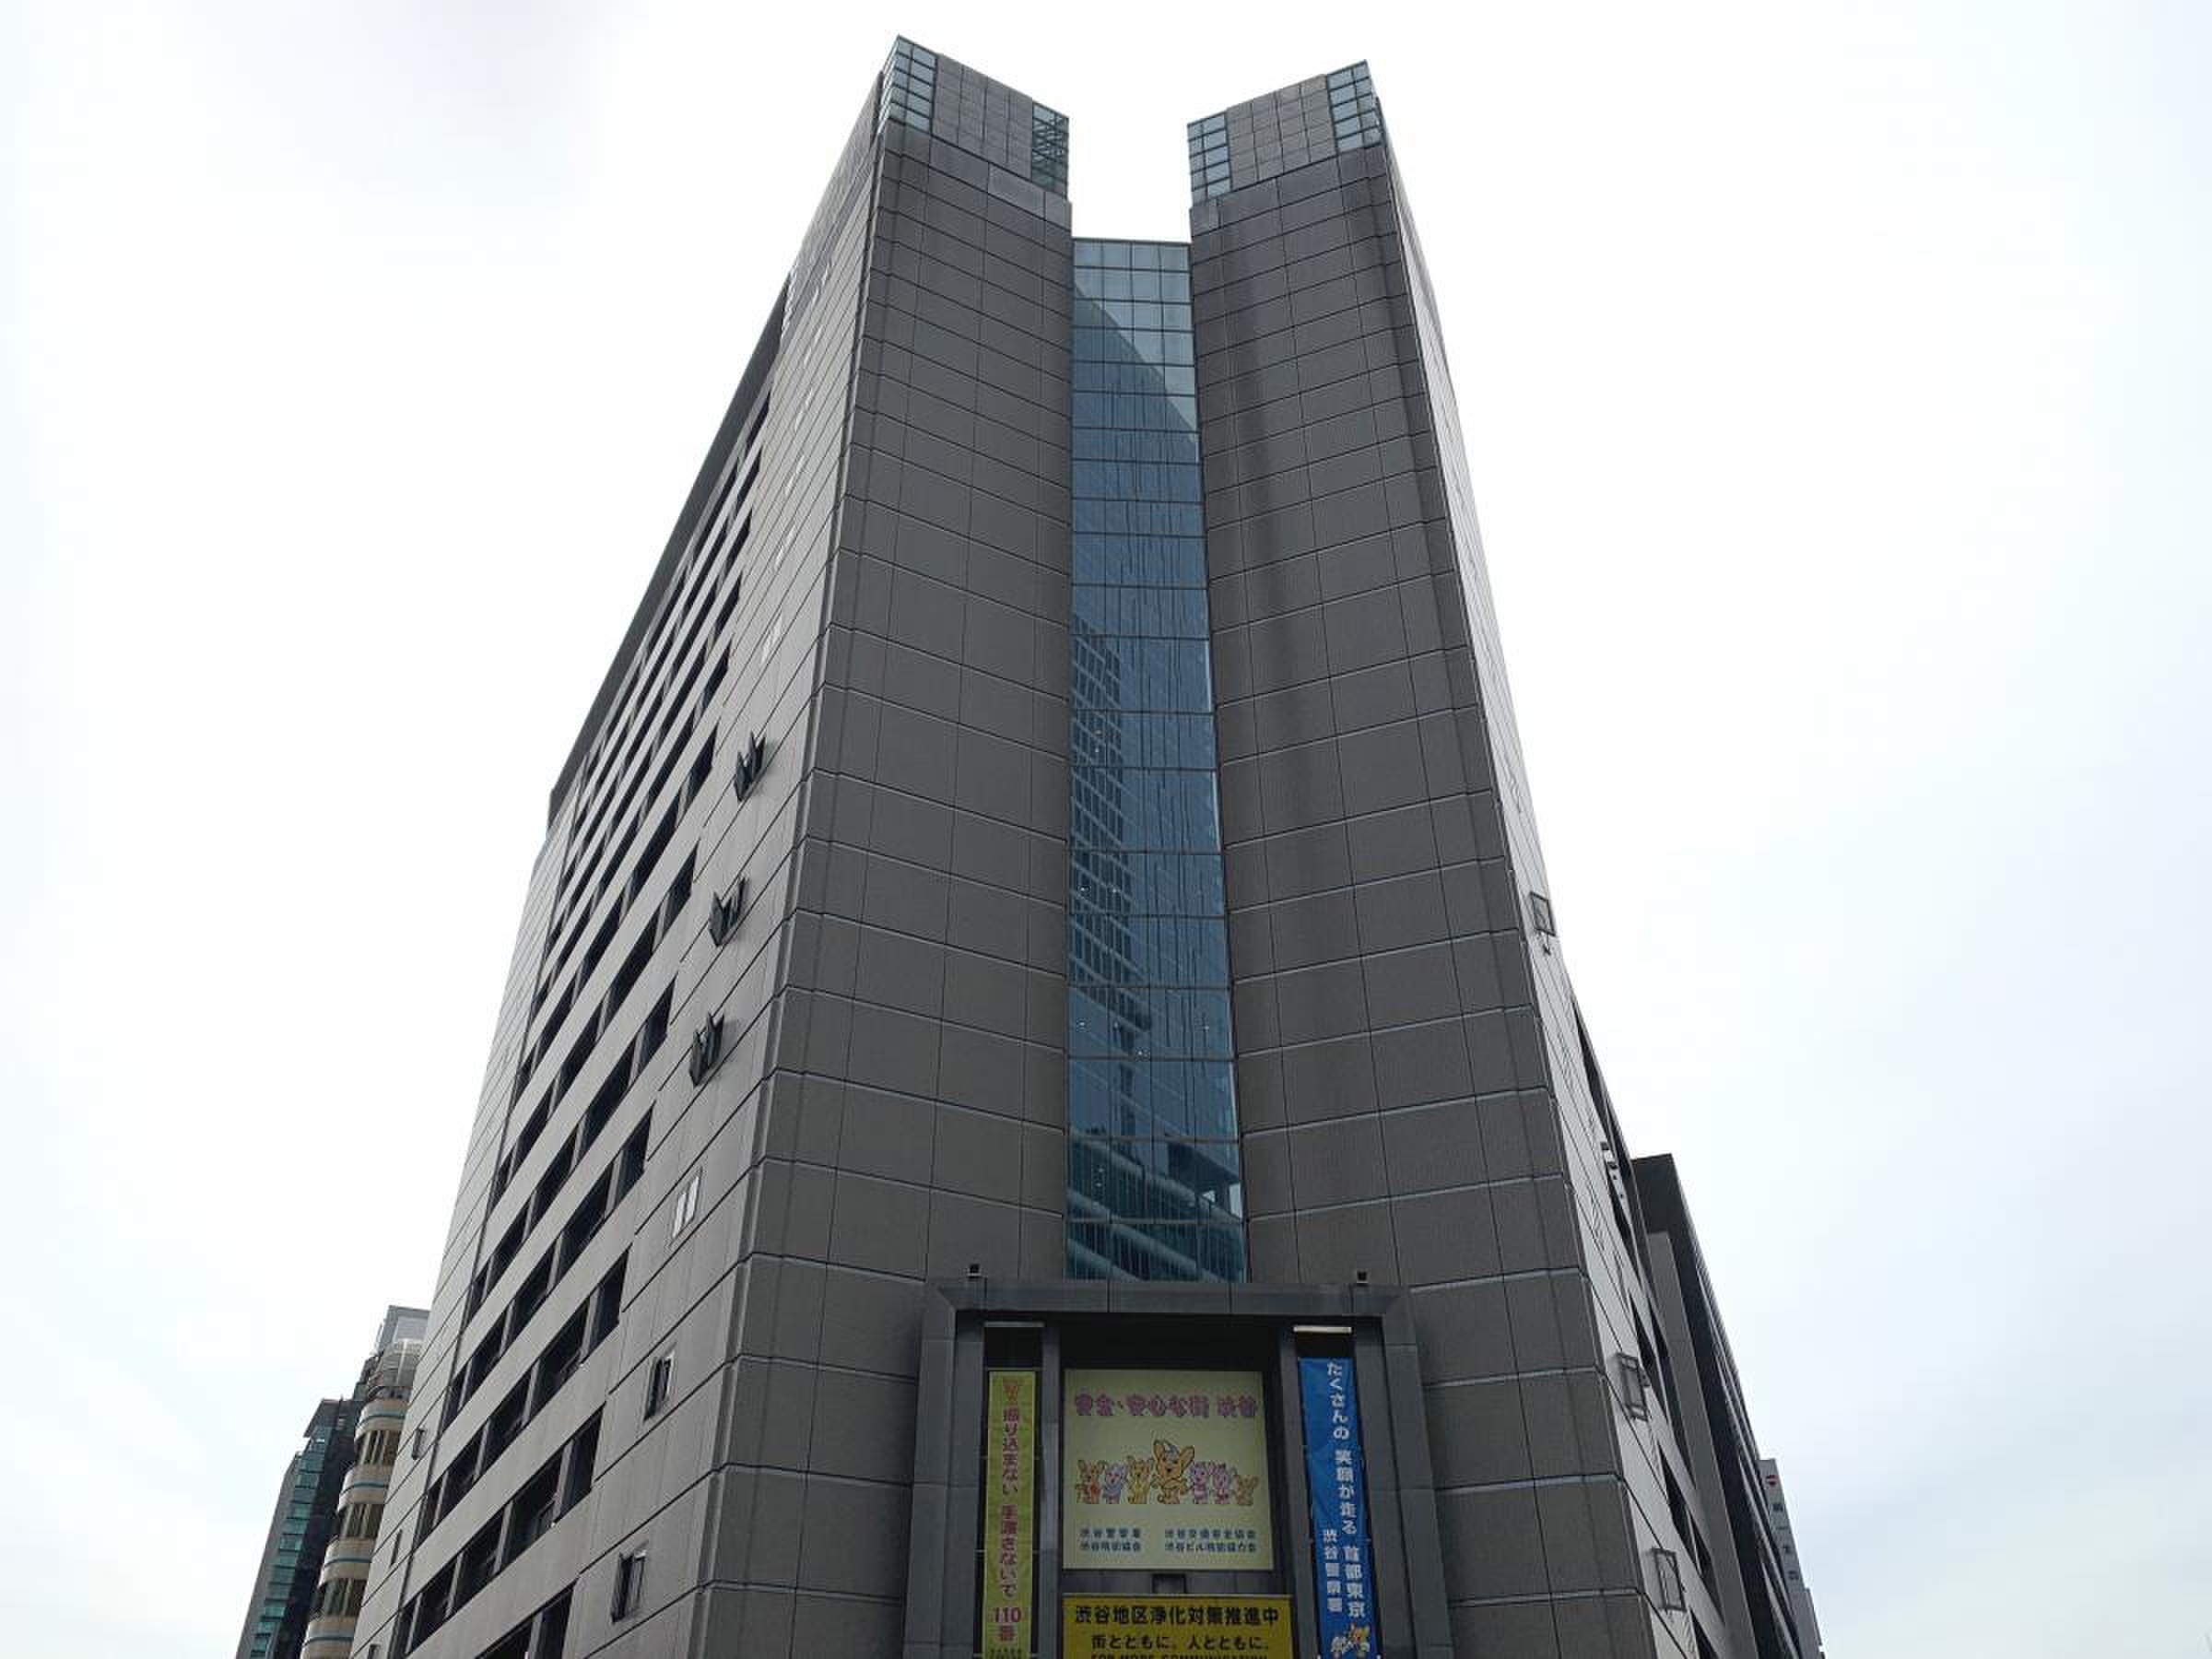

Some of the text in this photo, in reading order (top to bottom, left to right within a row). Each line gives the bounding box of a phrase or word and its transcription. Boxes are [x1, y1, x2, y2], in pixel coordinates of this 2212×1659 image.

[1327, 1358, 1349, 1440] たくさんの
[1075, 1605, 1279, 1627] 渋谷地区浄化対策推進中
